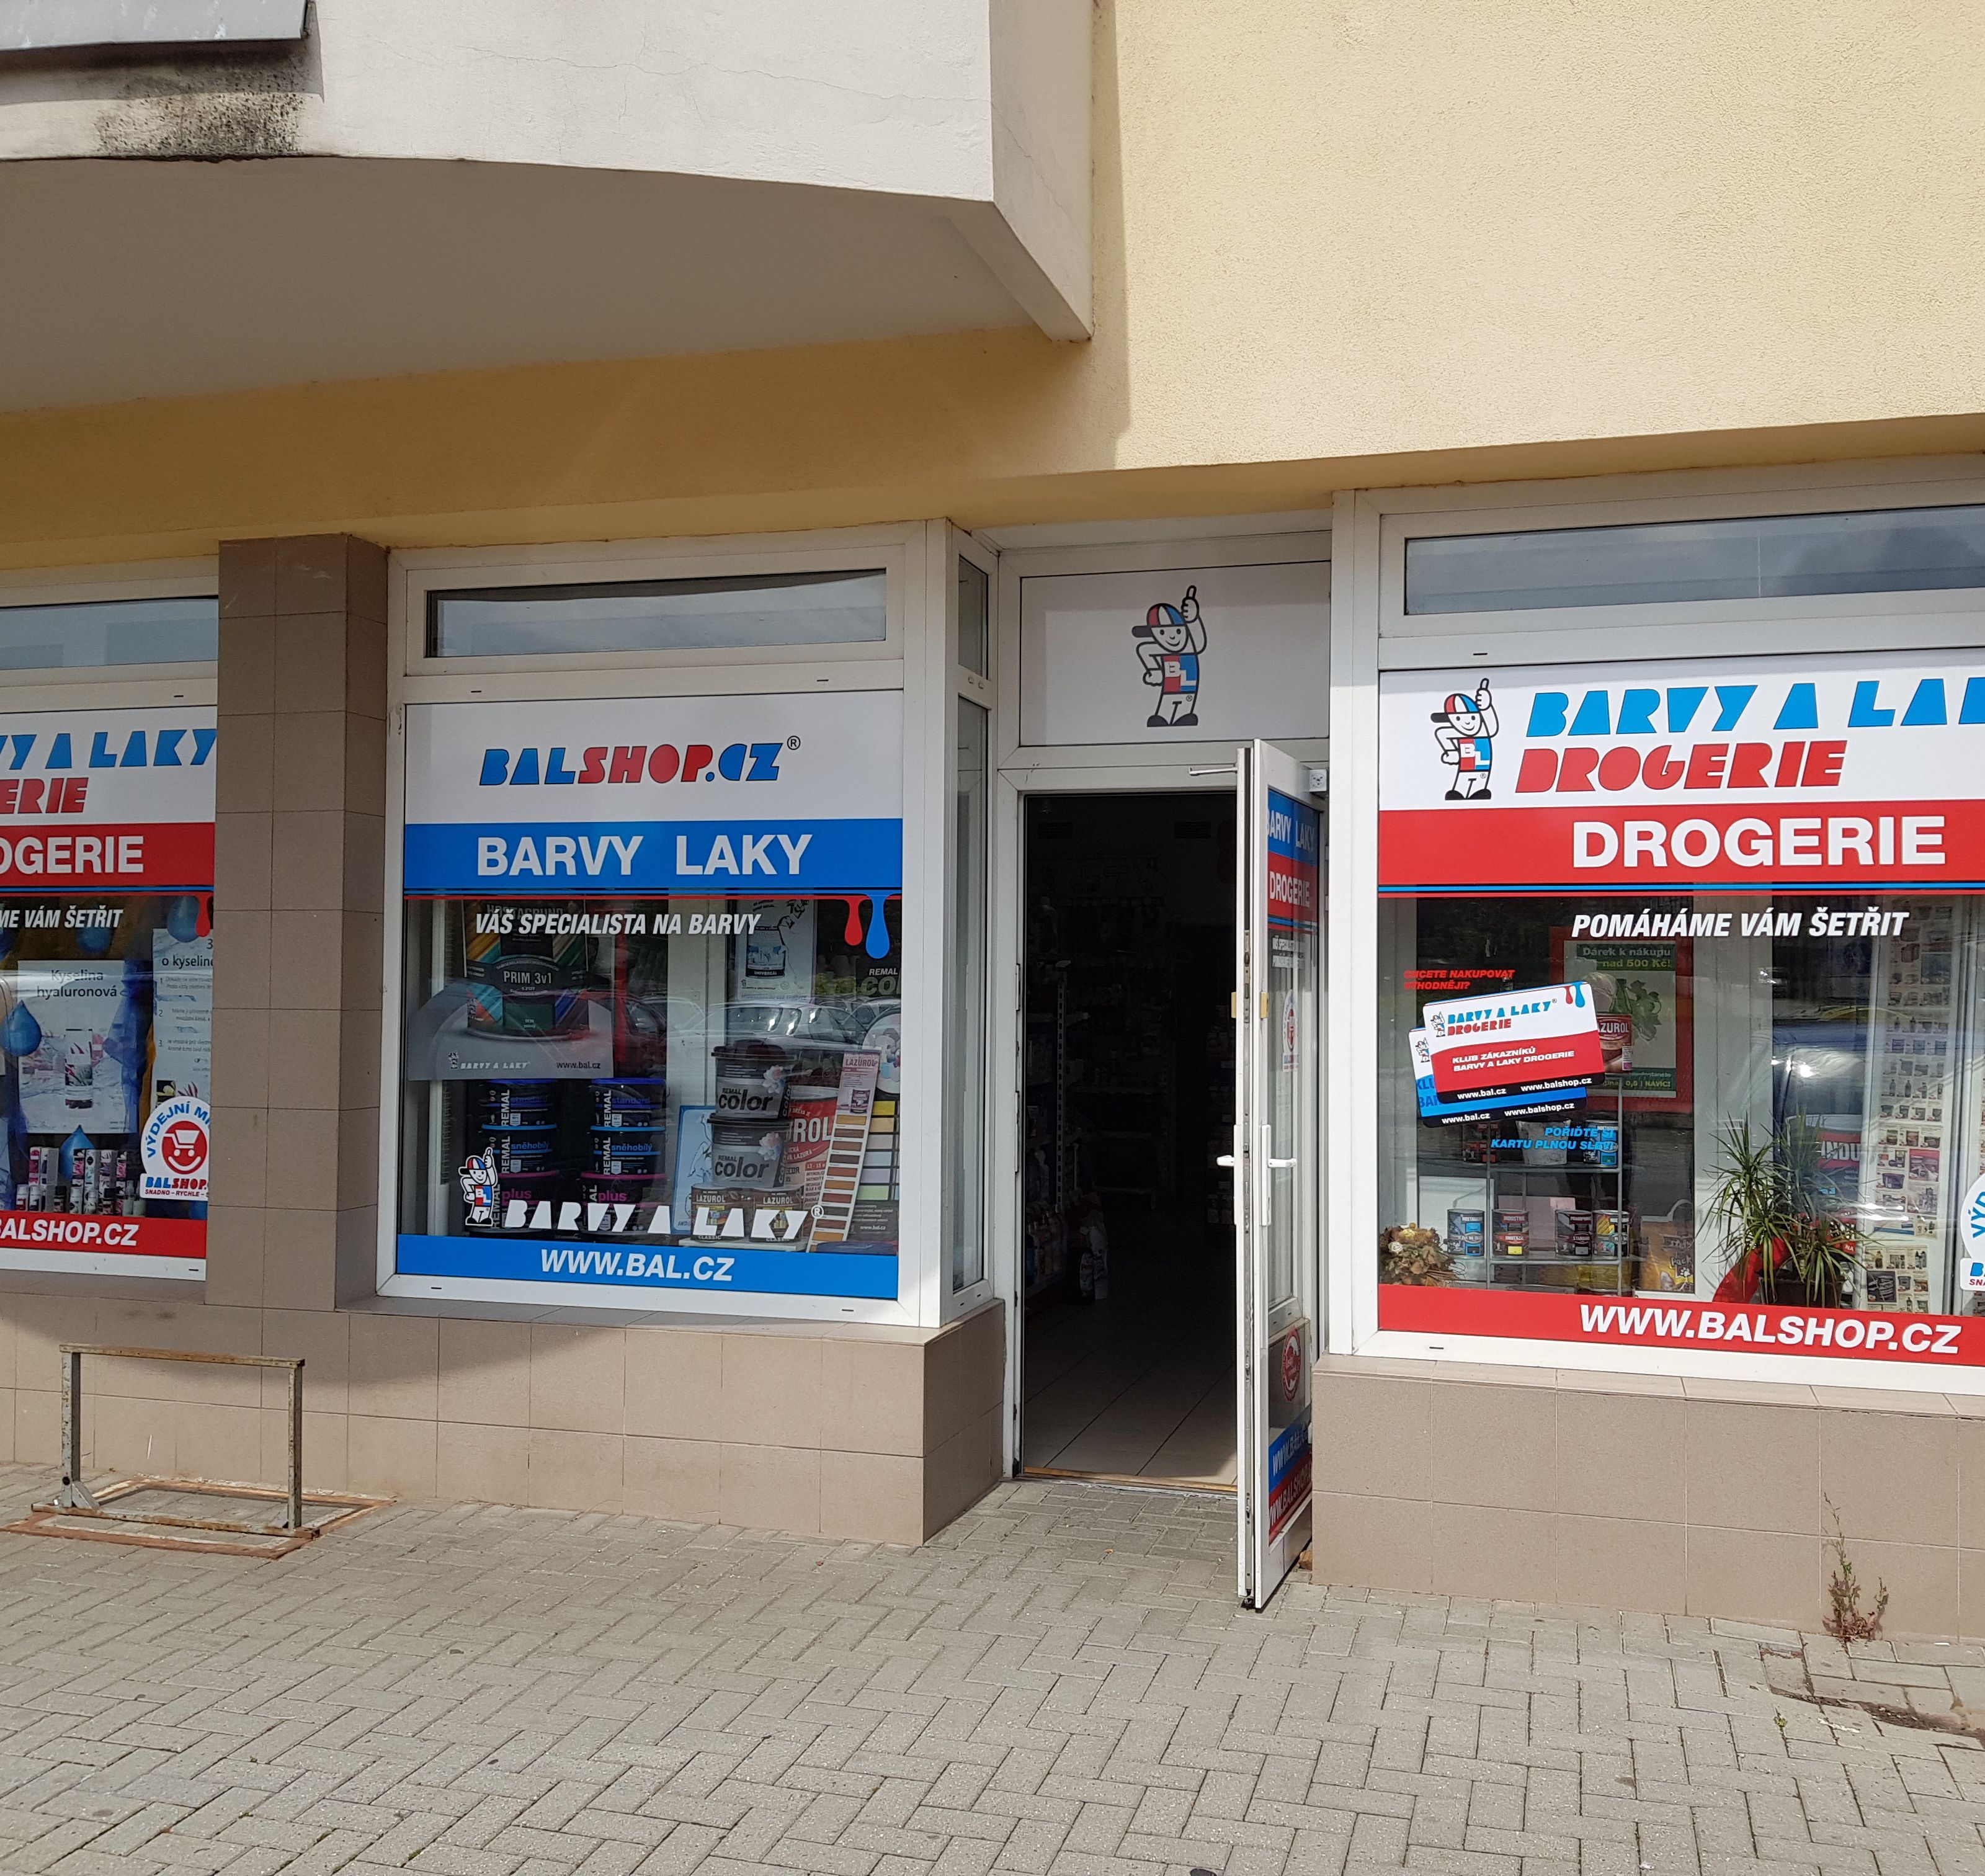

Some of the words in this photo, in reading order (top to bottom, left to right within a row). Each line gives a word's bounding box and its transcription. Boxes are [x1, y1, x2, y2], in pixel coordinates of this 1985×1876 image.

[1526, 685, 1758, 737] BARVY
[1773, 683, 1819, 730] A
[45, 733, 73, 769] A
[89, 728, 217, 769] LAKY
[1515, 740, 1847, 793] DROGERIE
[1573, 815, 1946, 868] DROGERIE
[478, 836, 644, 877] BARVY
[676, 834, 813, 875] LAKY
[1269, 870, 1310, 908] DROGERIE
[25, 905, 61, 928] VÁM
[64, 905, 124, 929] ŠETŘIT
[476, 908, 514, 934] VÁŠ
[519, 913, 646, 935] SPECIALISTA
[653, 914, 682, 935] NA
[688, 913, 762, 935] BARVY
[1571, 908, 1731, 938] POMÁHÁME
[1741, 908, 1802, 937] VÁM
[1809, 906, 1909, 937] ŠETŘIT
[1583, 947, 1615, 957] Dárek
[1620, 947, 1625, 957] k
[1630, 947, 1671, 957] nákupu
[869, 968, 898, 976] REMAL
[1449, 970, 1515, 979] NAKUPOVAT
[1626, 960, 1649, 968] 500
[51, 970, 104, 983] Kyselina
[504, 971, 530, 985] PRIM
[535, 973, 552, 985] 3v1
[37, 985, 117, 1000] hyaluronová
[1447, 1009, 1492, 1024] BARVY
[1496, 1007, 1505, 1018] A
[1510, 1001, 1551, 1016] LAKY
[1447, 1019, 1512, 1037] DROGERIE
[556, 1060, 601, 1070] www.bal.cz
[1452, 1055, 1478, 1065] KLUB
[1481, 1046, 1536, 1061] ZÁKAZNÍKŮ
[1453, 1061, 1484, 1072] BARVY
[1496, 1057, 1522, 1067] LAKY
[1523, 1050, 1574, 1063] DROGERIE
[1457, 1088, 1507, 1100] www.bal.cz
[1521, 1076, 1592, 1092] www.balshop.cz
[501, 1089, 510, 1127] REMAL
[604, 1090, 612, 1127] REMAL
[718, 1089, 774, 1111] color
[1442, 1112, 1490, 1124] www.bal.cz
[1504, 1102, 1575, 1117] www.balshop.cz
[145, 1101, 190, 1158] VÝDEJNÍ
[1544, 1125, 1599, 1137] POŘIĎTE
[501, 1136, 511, 1174] REMAL
[1491, 1139, 1532, 1150] KARTU
[1535, 1140, 1576, 1150] PLNOU
[603, 1137, 611, 1175] REMAL
[715, 1156, 770, 1178] color
[501, 1188, 532, 1200] plus
[598, 1189, 628, 1201] plus
[696, 1195, 726, 1203] LAZUROL
[763, 1197, 793, 1205] LAZUROL
[504, 1200, 636, 1233] BARVY
[648, 1205, 671, 1235] A
[693, 1207, 809, 1240] LAKY
[0, 1218, 140, 1246] ALSHOP.CZ
[541, 1249, 736, 1282] WWW.BAL.CZ
[1580, 1304, 1962, 1354] WWW.BALSHOP.CZ
